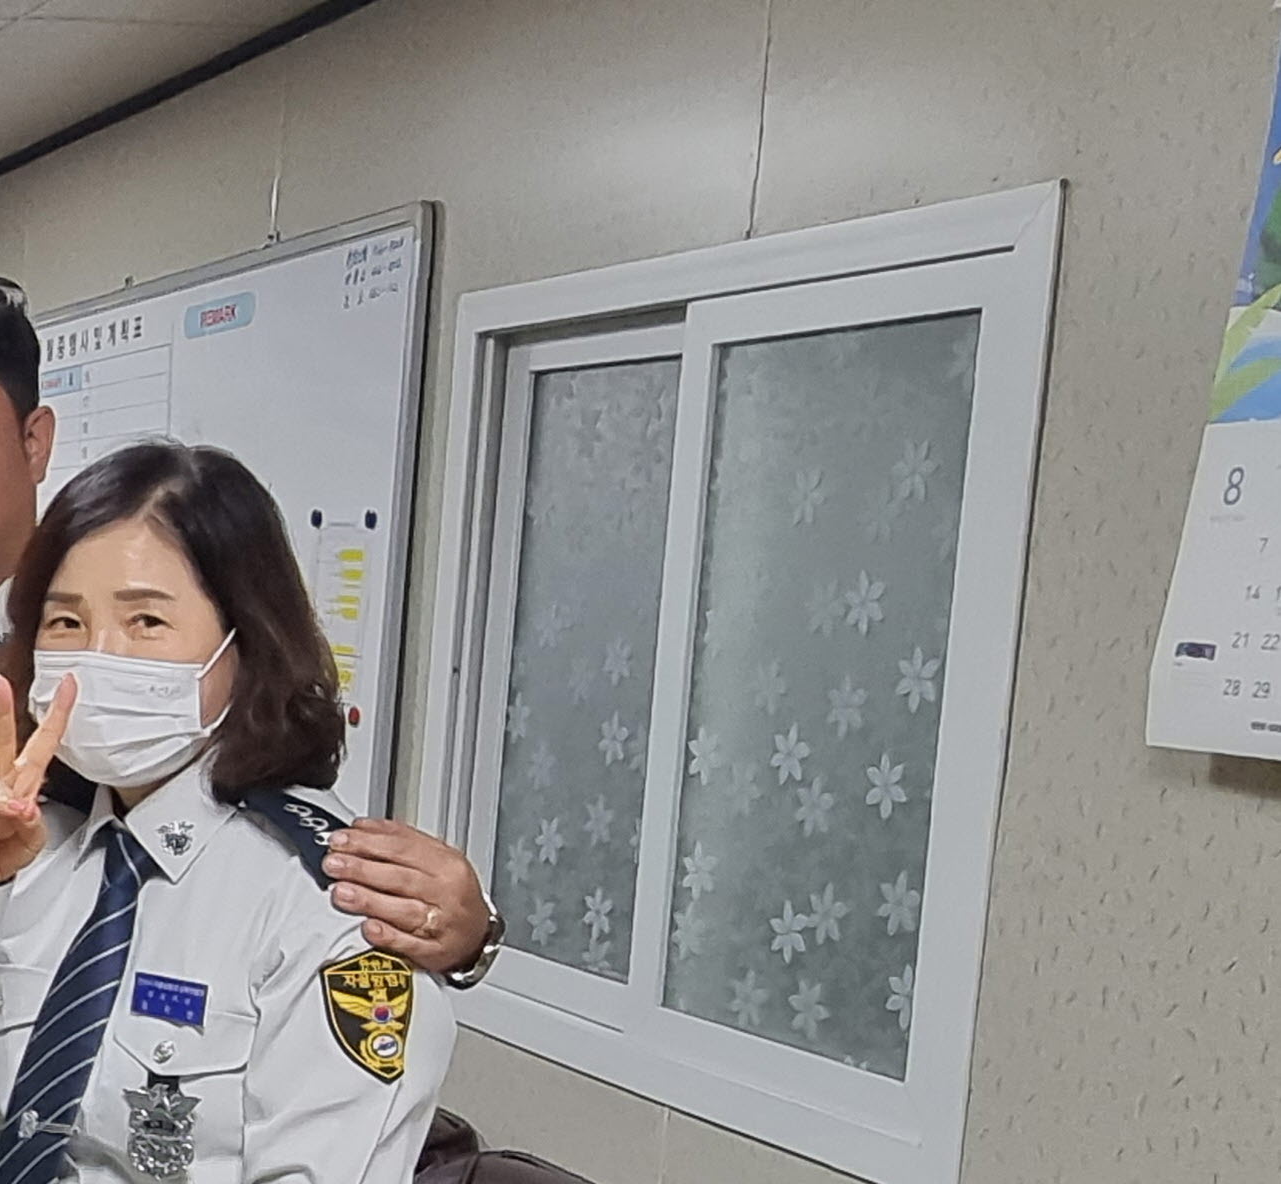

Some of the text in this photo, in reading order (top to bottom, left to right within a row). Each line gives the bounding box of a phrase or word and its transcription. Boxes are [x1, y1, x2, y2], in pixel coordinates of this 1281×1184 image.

[1223, 466, 1245, 506] 8
[1259, 537, 1269, 553] 7
[1231, 631, 1281, 651] 21 22
[1222, 678, 1271, 699] 28 29
